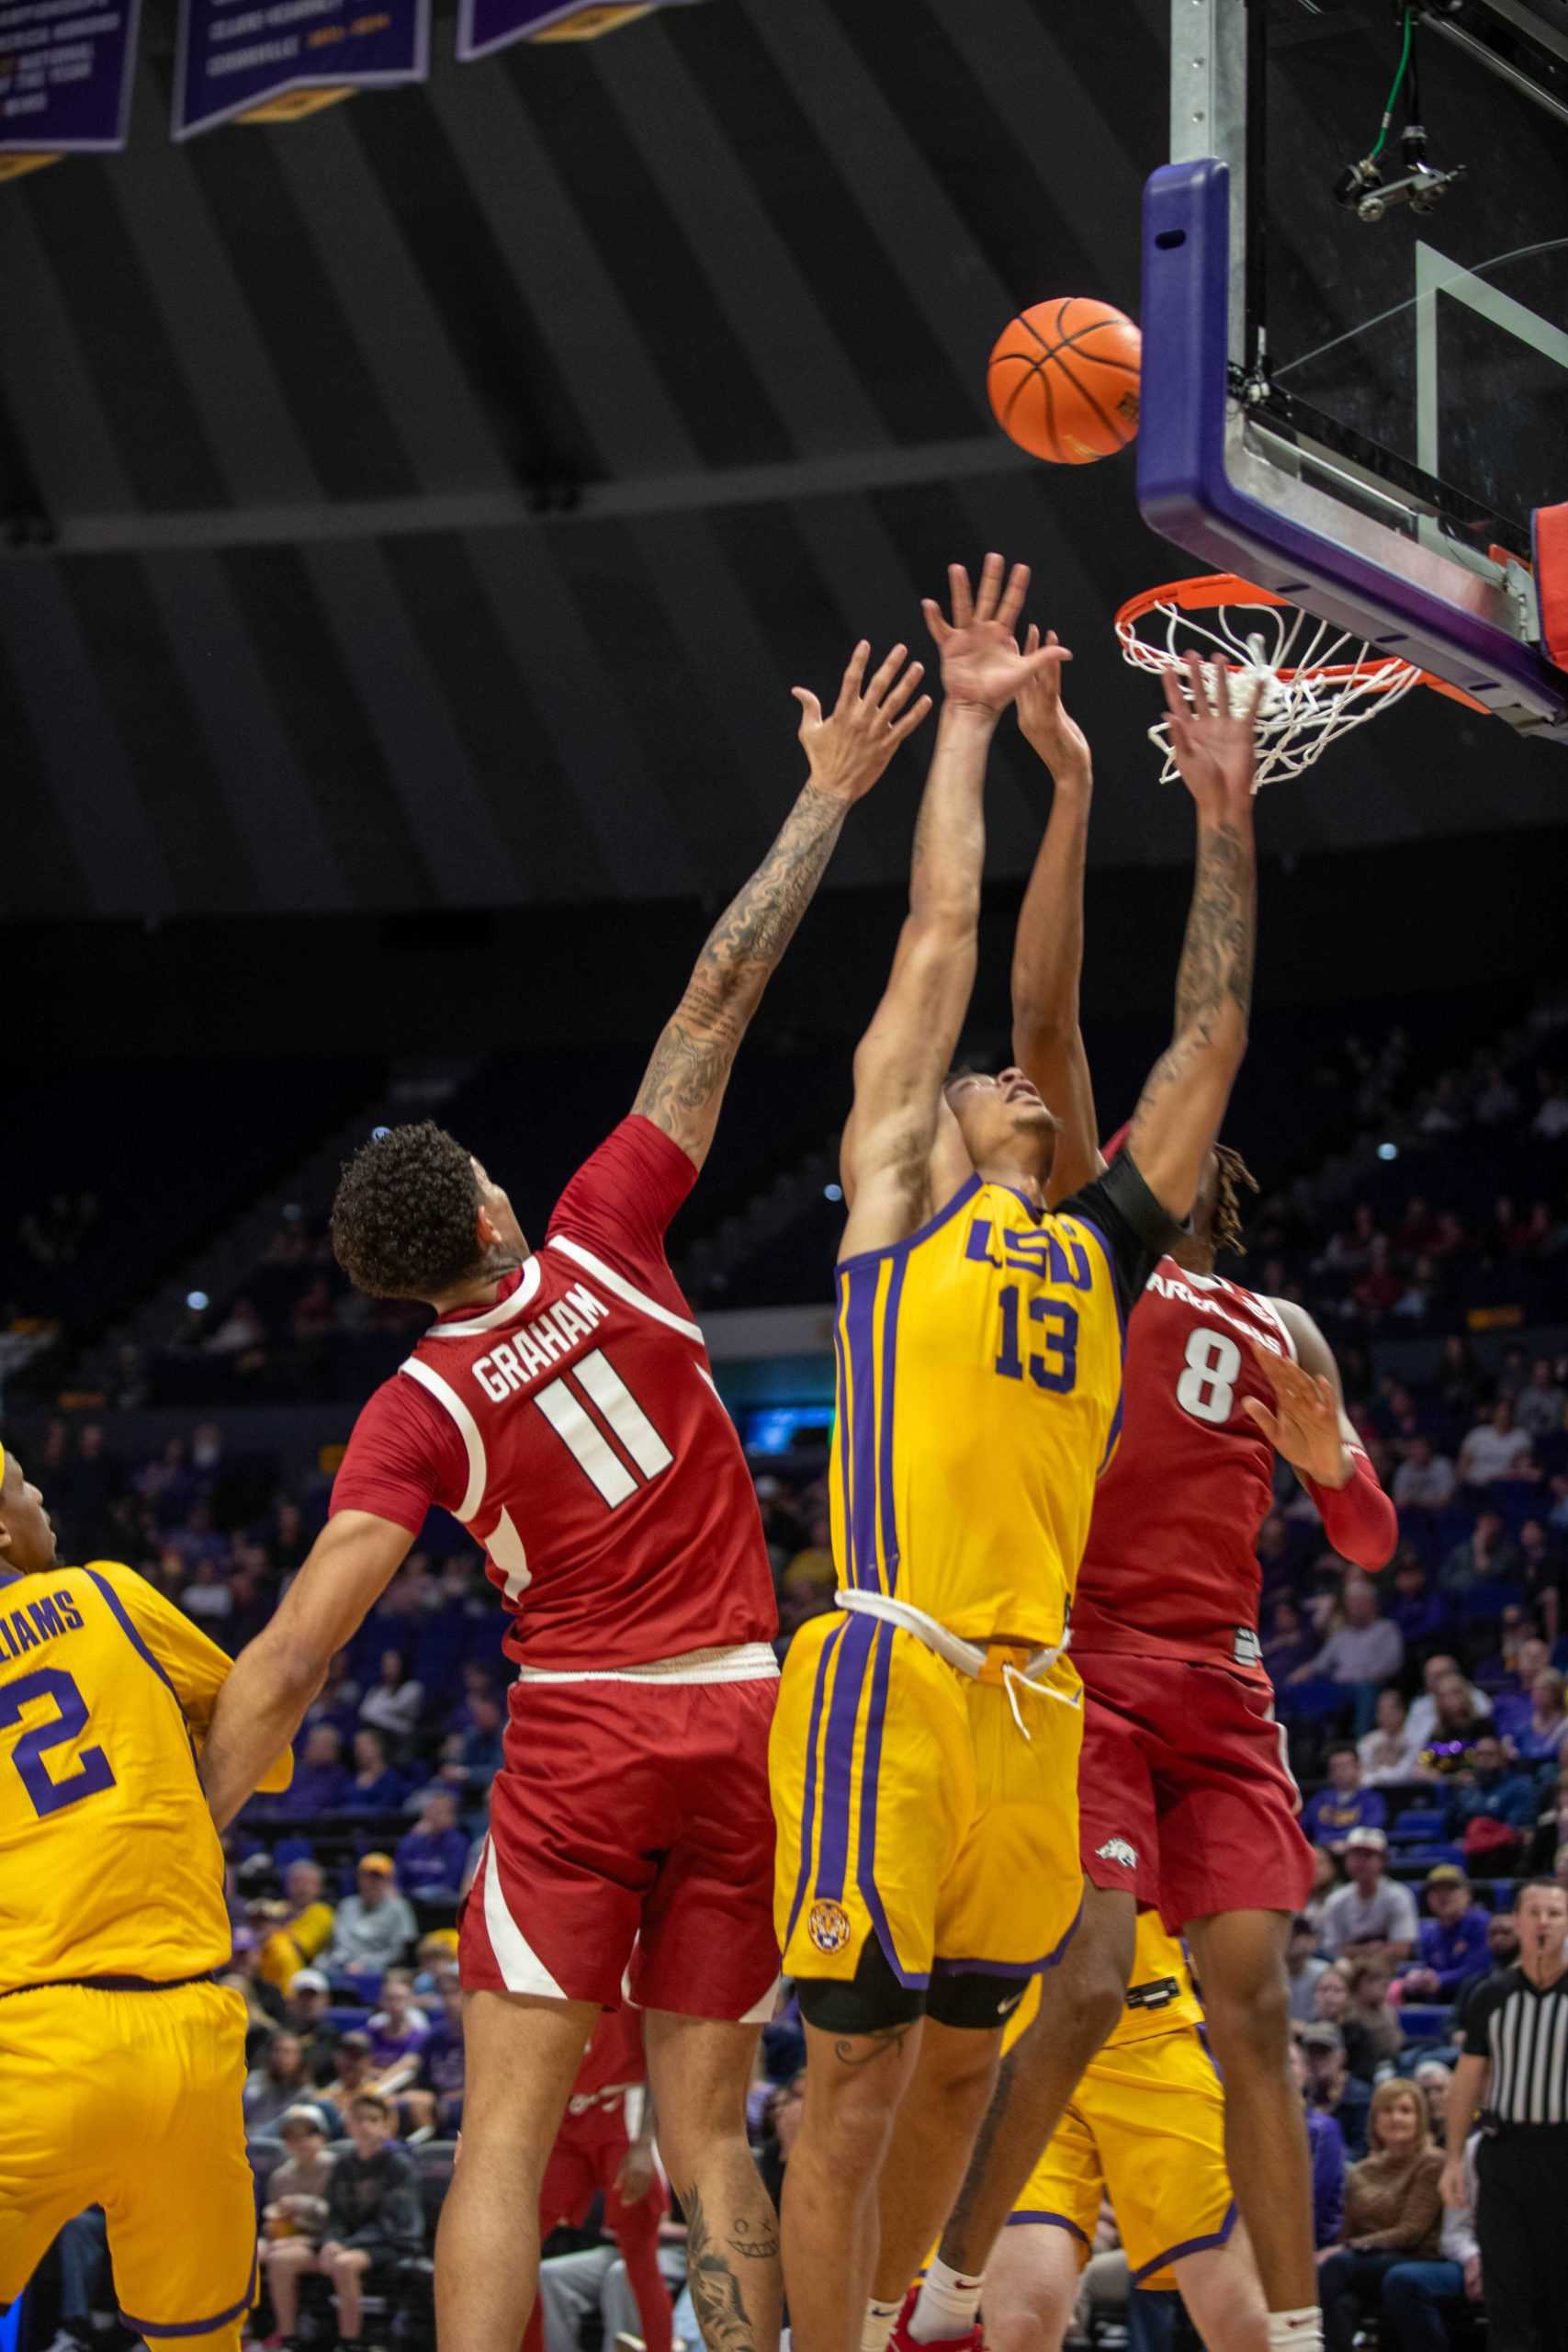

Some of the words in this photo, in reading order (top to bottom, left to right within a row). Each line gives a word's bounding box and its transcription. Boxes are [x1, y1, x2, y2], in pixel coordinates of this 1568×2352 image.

[965, 1220, 1092, 1291] LSU
[471, 1283, 610, 1403] GRAHAM
[995, 1284, 1079, 1395] 13
[1176, 1328, 1242, 1424] 8
[533, 1347, 674, 1510] 11
[0, 1667, 117, 1818] 2
